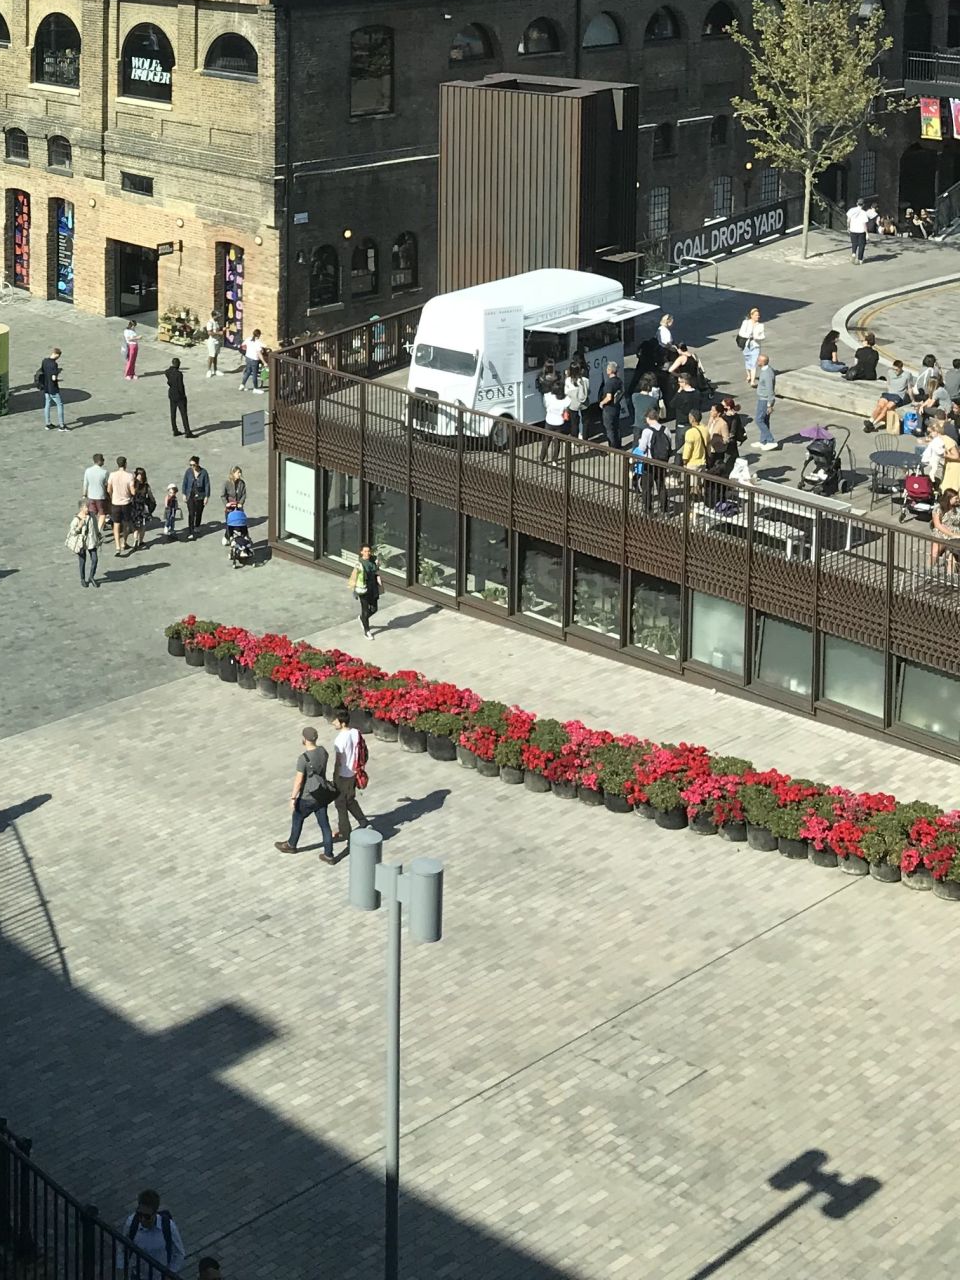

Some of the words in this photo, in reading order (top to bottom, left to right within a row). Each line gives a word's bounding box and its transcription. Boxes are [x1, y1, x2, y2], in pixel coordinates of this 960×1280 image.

[131, 56, 160, 70] WOLF
[131, 68, 171, 84] BADGER
[674, 233, 709, 264] COAL
[711, 218, 752, 252] DROPS
[753, 208, 784, 236] YARD
[477, 385, 514, 402] SONS
